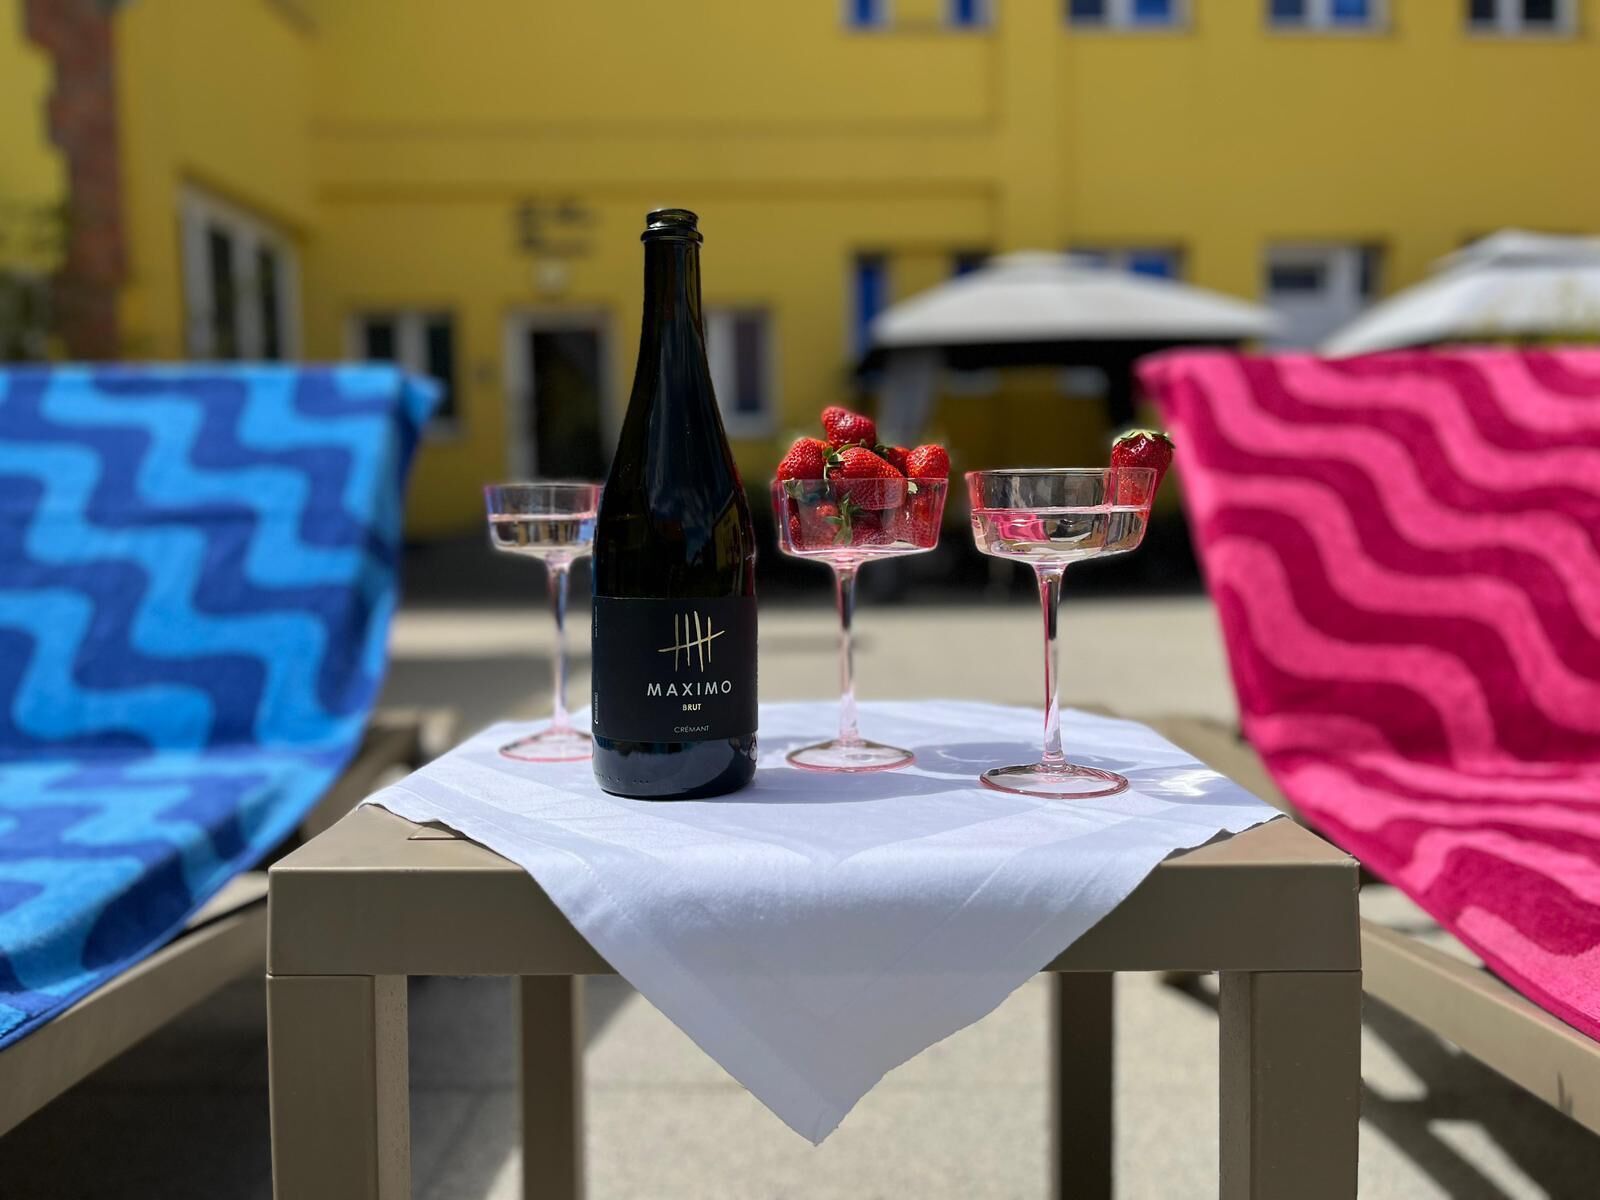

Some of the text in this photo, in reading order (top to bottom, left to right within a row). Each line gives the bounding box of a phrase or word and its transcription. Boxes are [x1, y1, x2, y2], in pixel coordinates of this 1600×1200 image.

[647, 680, 732, 697] MAXIMO
[682, 703, 702, 711] BRUT
[673, 725, 709, 733] CRÉMANT
